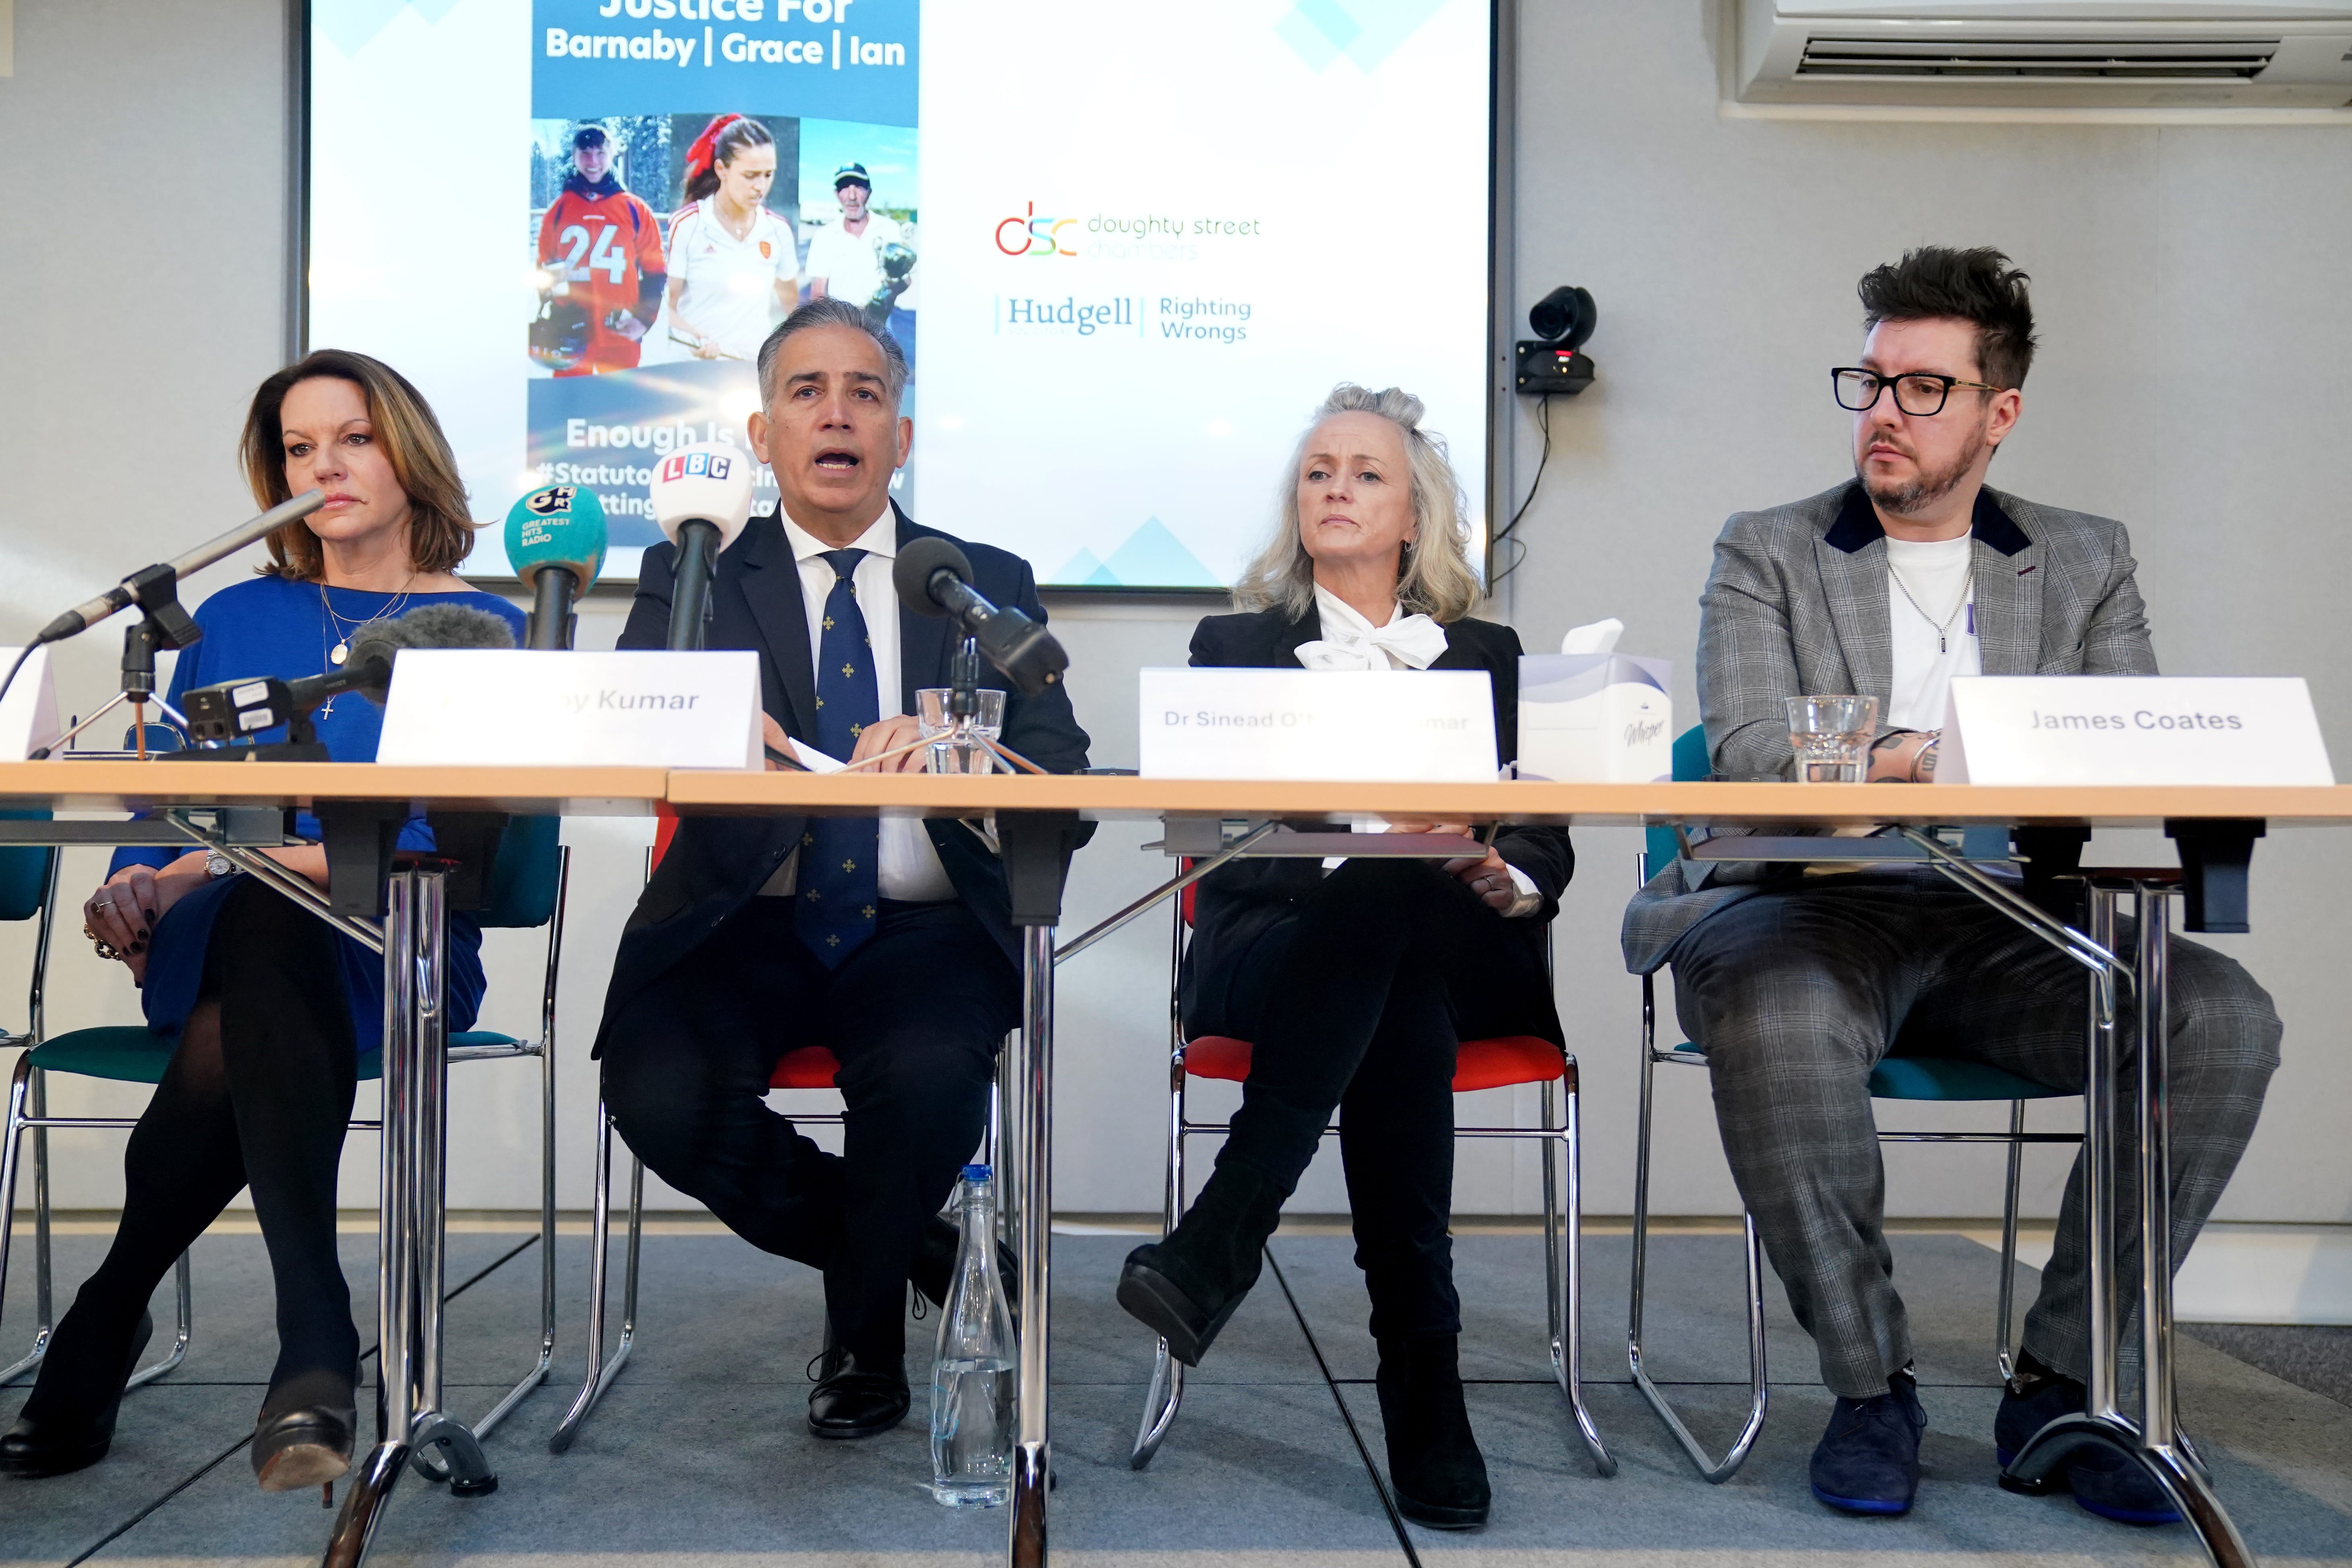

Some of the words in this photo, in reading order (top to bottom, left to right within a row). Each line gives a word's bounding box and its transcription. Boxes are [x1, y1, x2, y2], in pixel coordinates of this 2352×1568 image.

[777, 0, 853, 23] For
[546, 27, 696, 68] Barnaby
[721, 33, 823, 64] Grace
[850, 35, 905, 66] Ian
[1088, 214, 1183, 238] doughty
[1194, 218, 1260, 235] street
[560, 225, 626, 284] 24
[1008, 297, 1132, 335] Hudgell
[1161, 297, 1251, 320] Righting
[1161, 322, 1247, 344] Wrongs
[567, 418, 696, 455] Enough
[667, 454, 727, 479] LBC
[522, 518, 569, 530] GREATEST
[522, 527, 542, 538] HITS
[522, 534, 552, 547] RADIO
[599, 690, 699, 709] Kumar
[1165, 711, 1188, 726] Dr
[1196, 711, 1273, 727] Sinead
[2031, 711, 2125, 729] James
[2134, 710, 2243, 729] Coates
